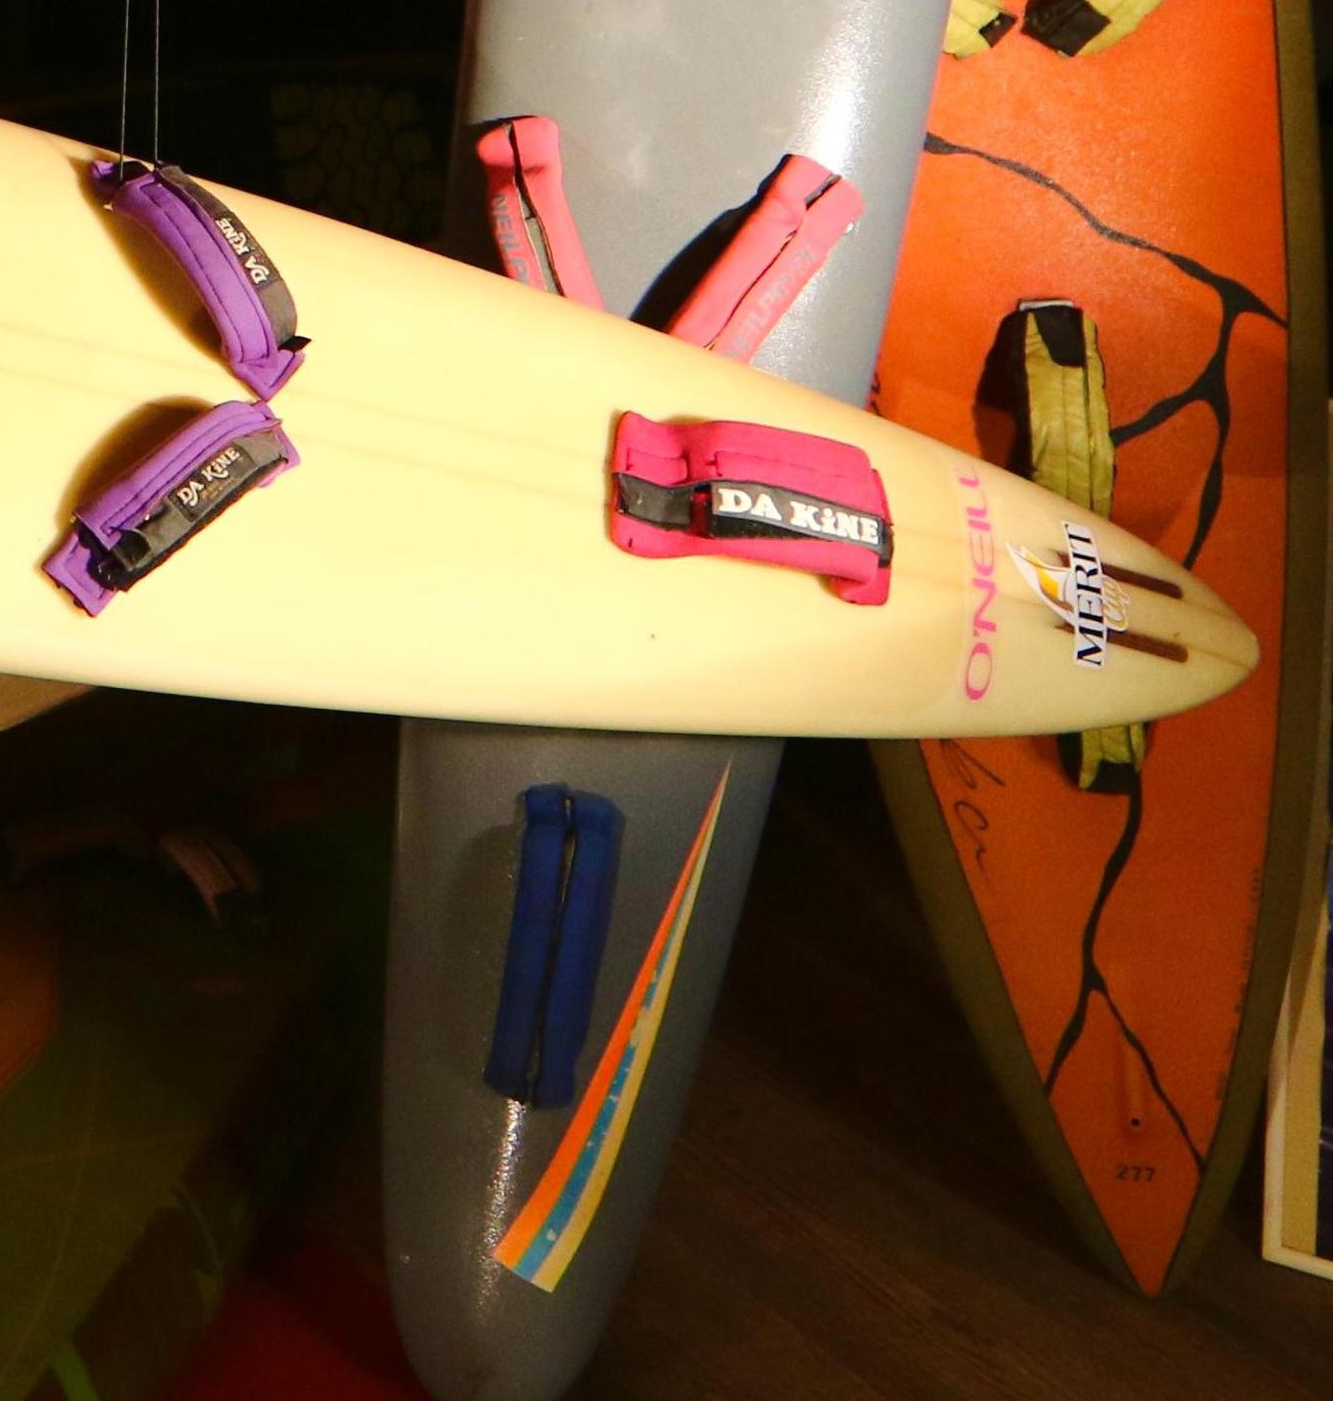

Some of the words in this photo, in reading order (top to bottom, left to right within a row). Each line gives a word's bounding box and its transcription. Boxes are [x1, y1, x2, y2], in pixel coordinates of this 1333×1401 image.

[244, 255, 271, 285] DA
[176, 480, 205, 507] DA
[717, 486, 783, 520] DA
[1066, 524, 1104, 666] MERIT
